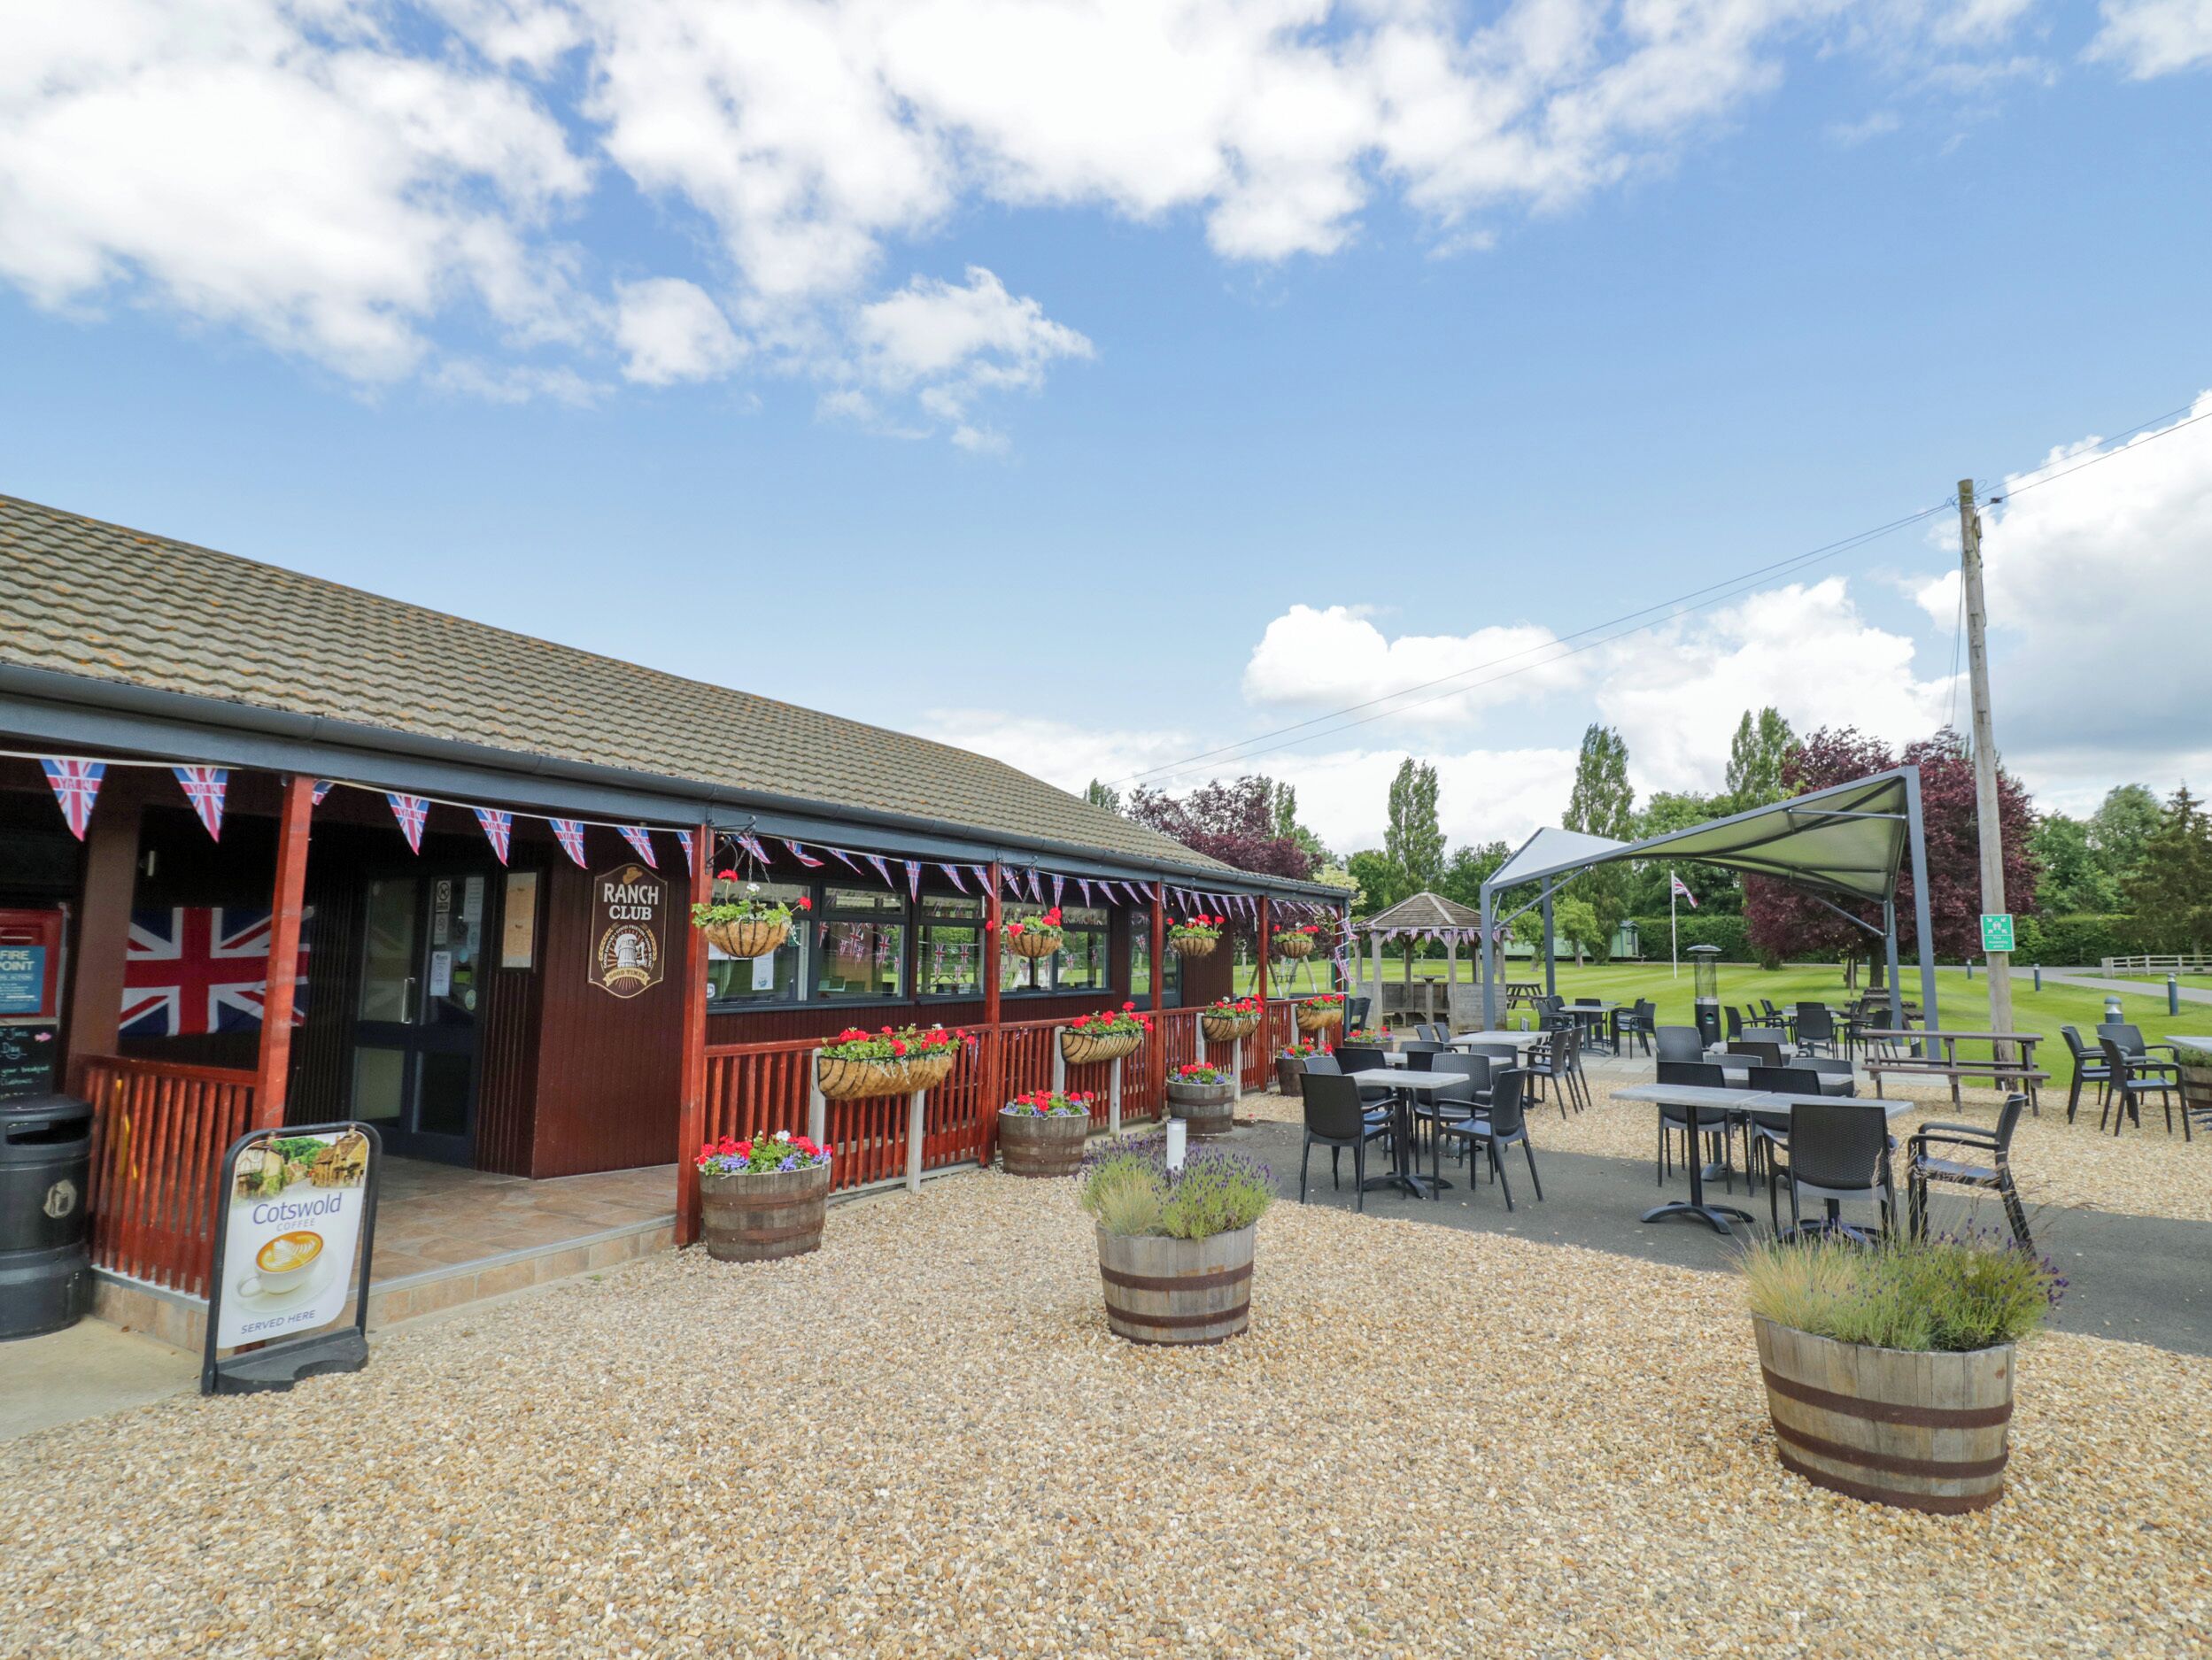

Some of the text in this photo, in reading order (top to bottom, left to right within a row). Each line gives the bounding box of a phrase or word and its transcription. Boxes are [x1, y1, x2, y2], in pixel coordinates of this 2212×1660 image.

[603, 883, 659, 905] RANCH
[608, 905, 653, 921] CLUB
[0, 950, 30, 961] FIRE
[0, 961, 35, 972] OINT
[608, 969, 646, 979] GOOD TIMES
[252, 1192, 343, 1225] Cotswold
[275, 1217, 316, 1232] COFFEE
[240, 1309, 316, 1335] SERVED HERE
